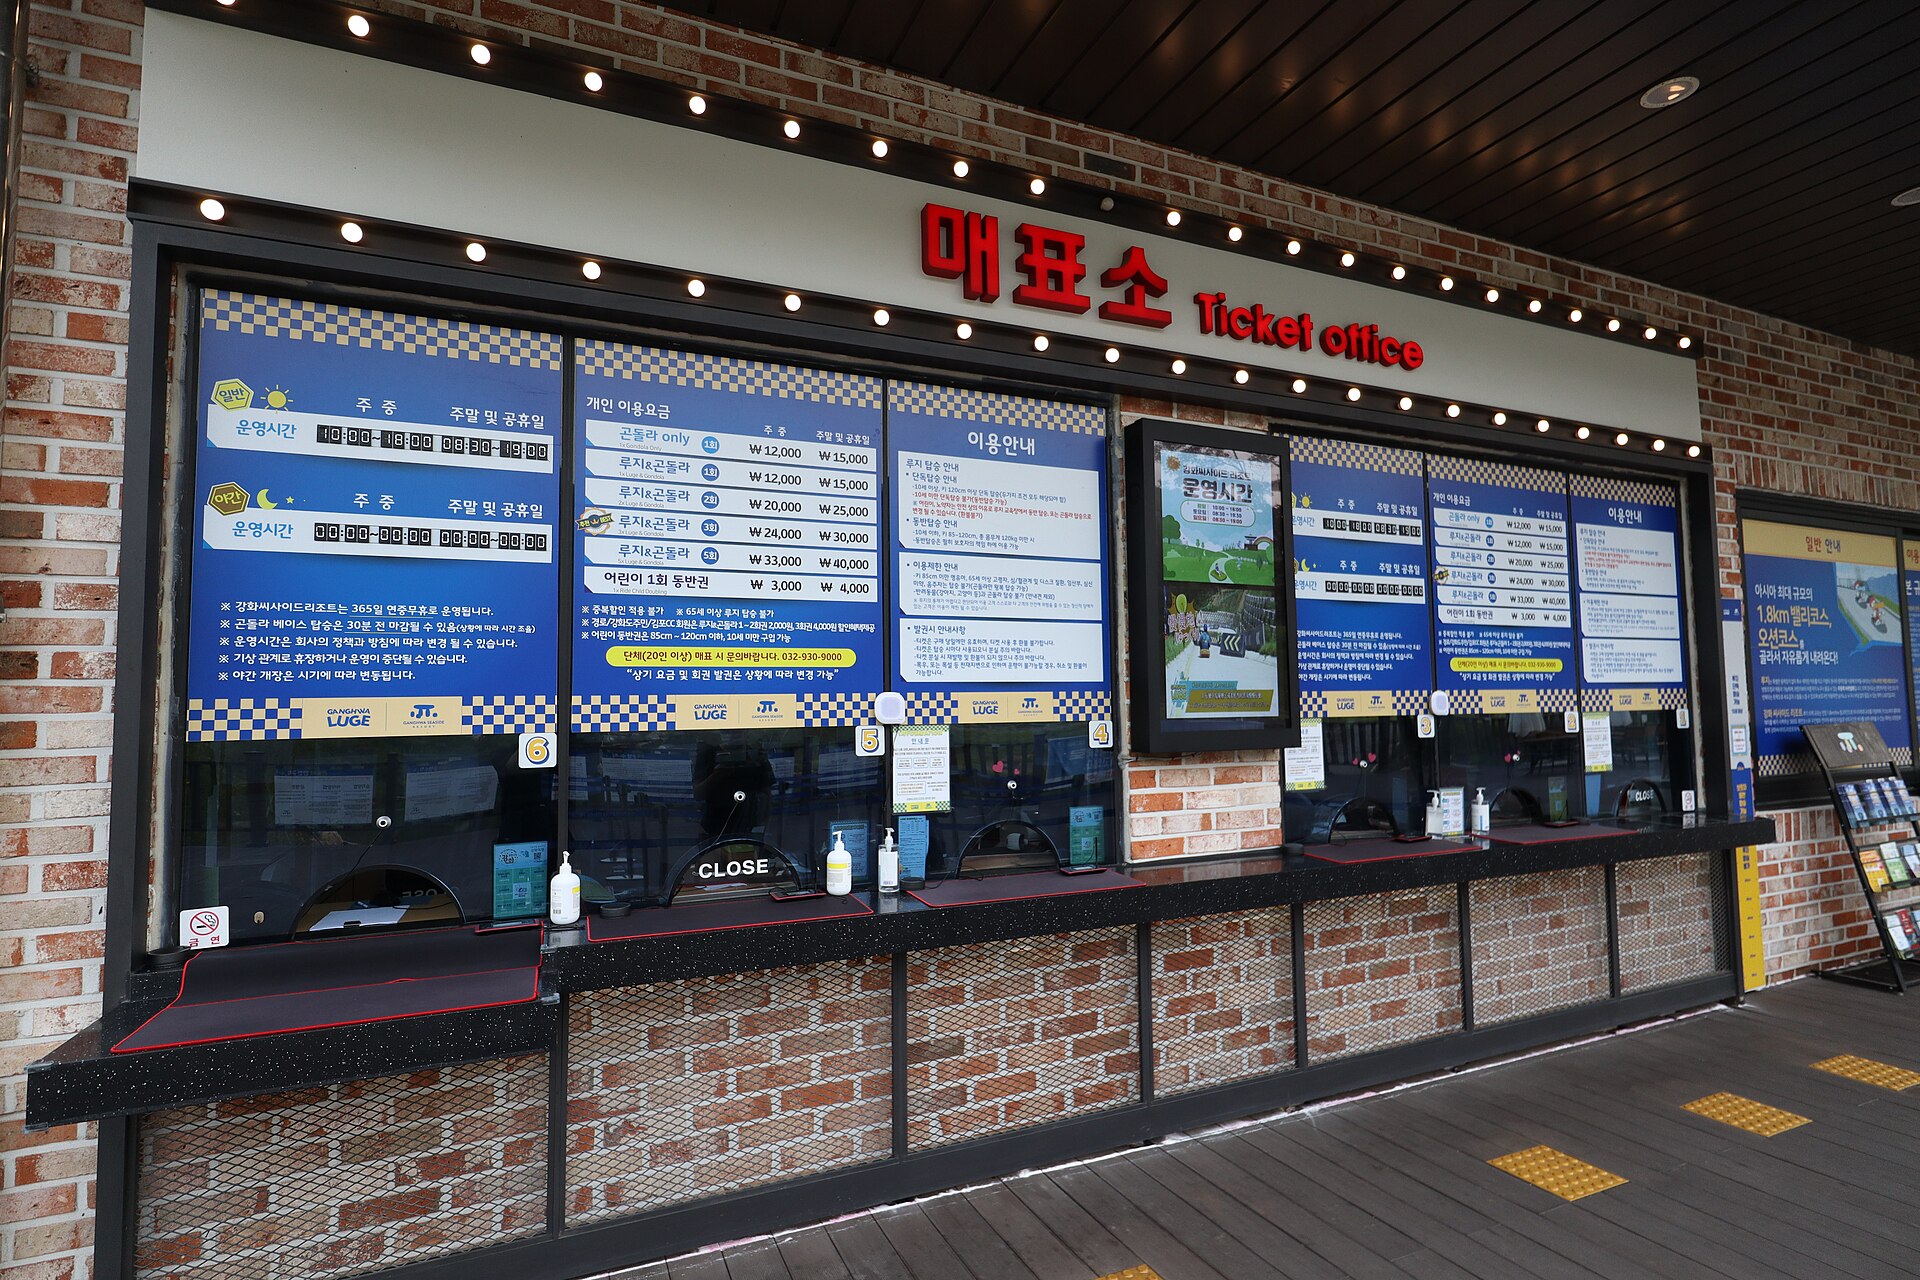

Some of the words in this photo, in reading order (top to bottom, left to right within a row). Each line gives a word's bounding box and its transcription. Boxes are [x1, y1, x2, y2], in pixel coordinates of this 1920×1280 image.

[921, 202, 1173, 329] 매표소
[1194, 292, 1313, 351] Ticket
[1319, 323, 1424, 370] office
[219, 388, 245, 400] 일반
[587, 397, 613, 413] 개인
[618, 400, 670, 419] 이용요금
[450, 407, 479, 422] 주말
[485, 409, 498, 424] 및
[503, 410, 545, 429] 공휴일
[236, 420, 296, 438] 운영시간
[620, 427, 658, 442] 곤돌라
[662, 431, 690, 446] only
[704, 439, 717, 450] 1회
[765, 446, 801, 459] 12,000
[834, 452, 868, 465] 15,000
[816, 431, 832, 442] 주말
[835, 432, 843, 442] 및
[846, 432, 869, 445] 공휴일
[968, 432, 1035, 456] 이용안내
[906, 459, 922, 468] 루지
[925, 460, 940, 470] 탑승
[943, 462, 959, 472] 안내
[620, 456, 690, 472] 루지&곤돌라
[704, 467, 717, 478] 1회
[765, 473, 801, 486] 12,000
[834, 479, 868, 492] 15,000
[913, 472, 940, 483] 단독탑승
[943, 475, 957, 484] 안내
[214, 492, 242, 503] 야간
[1182, 478, 1252, 503] 운영시간
[619, 486, 690, 502] 루지&곤돌라
[704, 495, 716, 506] 2회
[765, 501, 801, 513] 20,000
[834, 506, 868, 518] 25,000
[1433, 493, 1445, 503] 개인
[1447, 495, 1470, 506] 이용요금
[448, 499, 478, 514] 주말
[484, 502, 497, 516] 및
[501, 502, 543, 519] 공휴일
[1608, 508, 1642, 523] 이용안내
[232, 521, 293, 539] 운영시간
[619, 516, 690, 530] 루지&곤돌라
[704, 523, 716, 533] 3회
[765, 528, 801, 540] 24,000
[834, 532, 868, 544] 30,000
[1806, 537, 1821, 552] 일반
[1825, 538, 1840, 553] 안내
[619, 545, 690, 560] 루지&곤돌라
[704, 551, 716, 561] 5회
[765, 556, 801, 568] 33,000
[834, 558, 868, 570] 40,000
[604, 573, 642, 585] 어린이
[648, 574, 667, 586] 1회
[672, 575, 709, 589] 동반권
[772, 581, 801, 593] 3,000
[840, 584, 869, 595] 4,000
[1755, 584, 1776, 598] 아시아
[1778, 585, 1791, 599] 최대
[1793, 587, 1813, 601] 규모의
[235, 602, 348, 614] 강화씨사이드리조트는
[352, 604, 383, 615] 365일
[387, 605, 438, 616] 연중무휴로
[442, 606, 494, 616] 운영됩니다.
[1758, 606, 1789, 624] 1.8km
[1791, 608, 1832, 628] 밸리코스,
[234, 619, 270, 630] 곤돌라
[273, 619, 307, 630] 베이스
[311, 620, 344, 631] 탑승은
[347, 621, 372, 631] 30분
[375, 621, 385, 631] 전
[389, 621, 419, 632] 마감될
[423, 622, 433, 632] 수
[914, 625, 936, 634] 발권시
[938, 625, 966, 634] 안내사항
[234, 636, 291, 647] 운영시간은
[296, 636, 328, 647] 회사의
[332, 637, 365, 647] 정책과
[368, 637, 400, 648] 방침에
[404, 638, 423, 648] 따라
[427, 638, 446, 648] 변경
[451, 638, 460, 648] 될
[463, 638, 473, 648] 수
[477, 638, 518, 649] 있습니다.
[234, 653, 255, 663] 기상
[259, 653, 291, 664] 관계로
[294, 653, 347, 664] 휴장하거나
[349, 654, 379, 664] 운영이
[383, 654, 412, 664] 중단될
[415, 654, 424, 664] 수
[427, 654, 467, 664] 있습니다.
[624, 651, 667, 662] 단체(20인
[670, 652, 692, 662] 이상)
[695, 652, 712, 662] 매표
[716, 652, 724, 662] 시
[727, 652, 779, 662] 문의바랍니다.
[782, 652, 842, 662] 032-930-9000
[1760, 650, 1780, 664] 골라서
[1782, 651, 1809, 664] 자유롭게
[1811, 651, 1838, 664] 내려온다!
[233, 670, 256, 681] 야간
[260, 670, 294, 681] 개장은
[298, 670, 331, 680] 시기에
[335, 670, 356, 680] 따라
[360, 670, 416, 681] 변동됩니다.
[656, 670, 674, 680] 요금
[680, 670, 688, 680] 및
[692, 670, 710, 680] 회권
[714, 670, 742, 680] 발권은
[745, 670, 772, 679] 상황에
[776, 670, 793, 680] 따라
[796, 670, 814, 680] 변경
[694, 710, 726, 720] LUGE
[973, 706, 998, 714] LUGE
[328, 716, 370, 727] LUGE
[1421, 718, 1431, 735] 3
[1567, 715, 1576, 729] 2
[861, 729, 879, 752] 5
[1094, 724, 1109, 745] 4
[525, 737, 550, 765] 6
[1636, 790, 1653, 801] CLOSE
[698, 859, 768, 878] CLOSE
